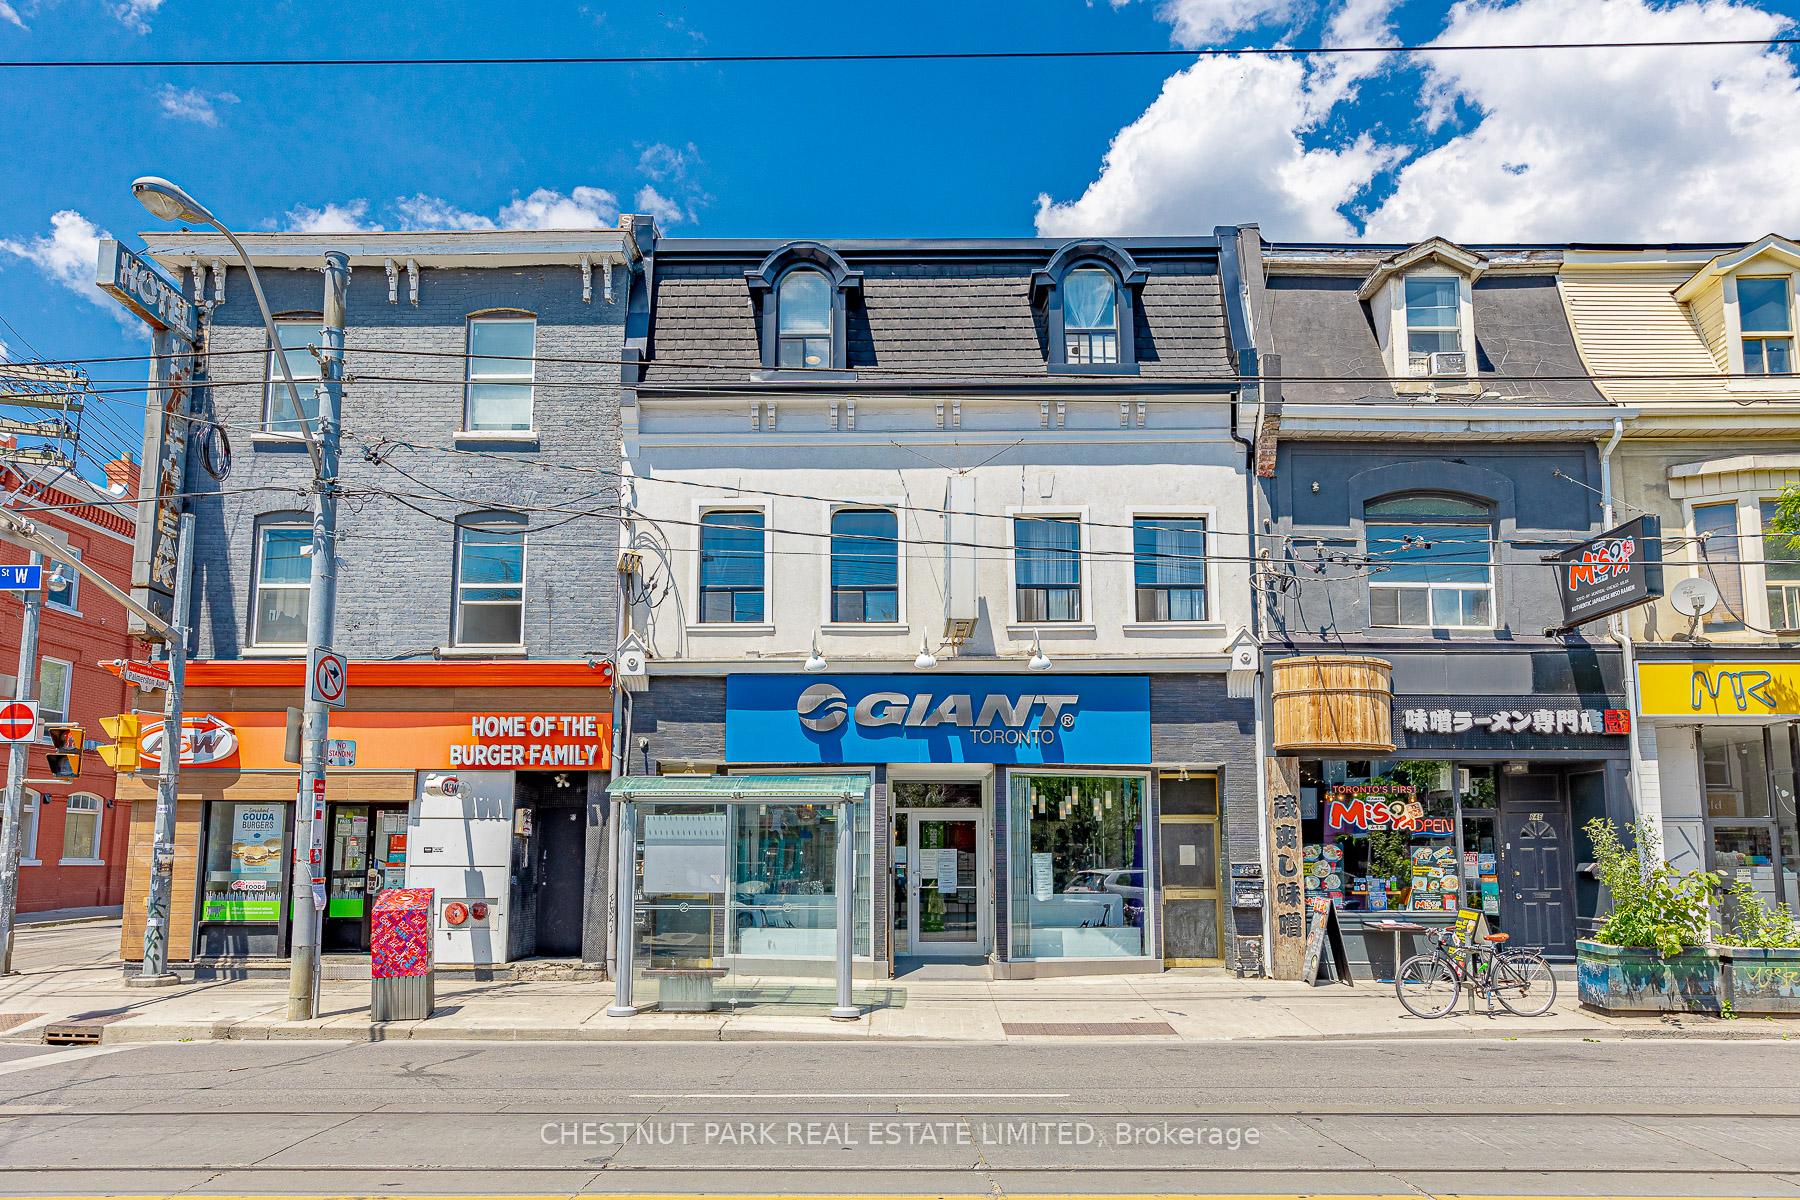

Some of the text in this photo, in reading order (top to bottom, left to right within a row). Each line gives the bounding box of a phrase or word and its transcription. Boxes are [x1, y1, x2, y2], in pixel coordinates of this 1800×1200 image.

[1, 567, 29, 584] St W
[128, 671, 155, 686] Palmerston
[855, 691, 1079, 727] GIANT
[471, 716, 597, 737] HOME OF THE
[1403, 708, 1604, 734] 味噌ラーメン専門店
[970, 729, 1055, 745] TORONTO
[328, 750, 354, 758] STANDING
[449, 744, 598, 766] BURGER FAMILY
[1332, 785, 1388, 794] TORONTO'S
[242, 813, 275, 821] GOUDA
[242, 821, 274, 829] BURGERS
[1413, 818, 1454, 833] OPEN
